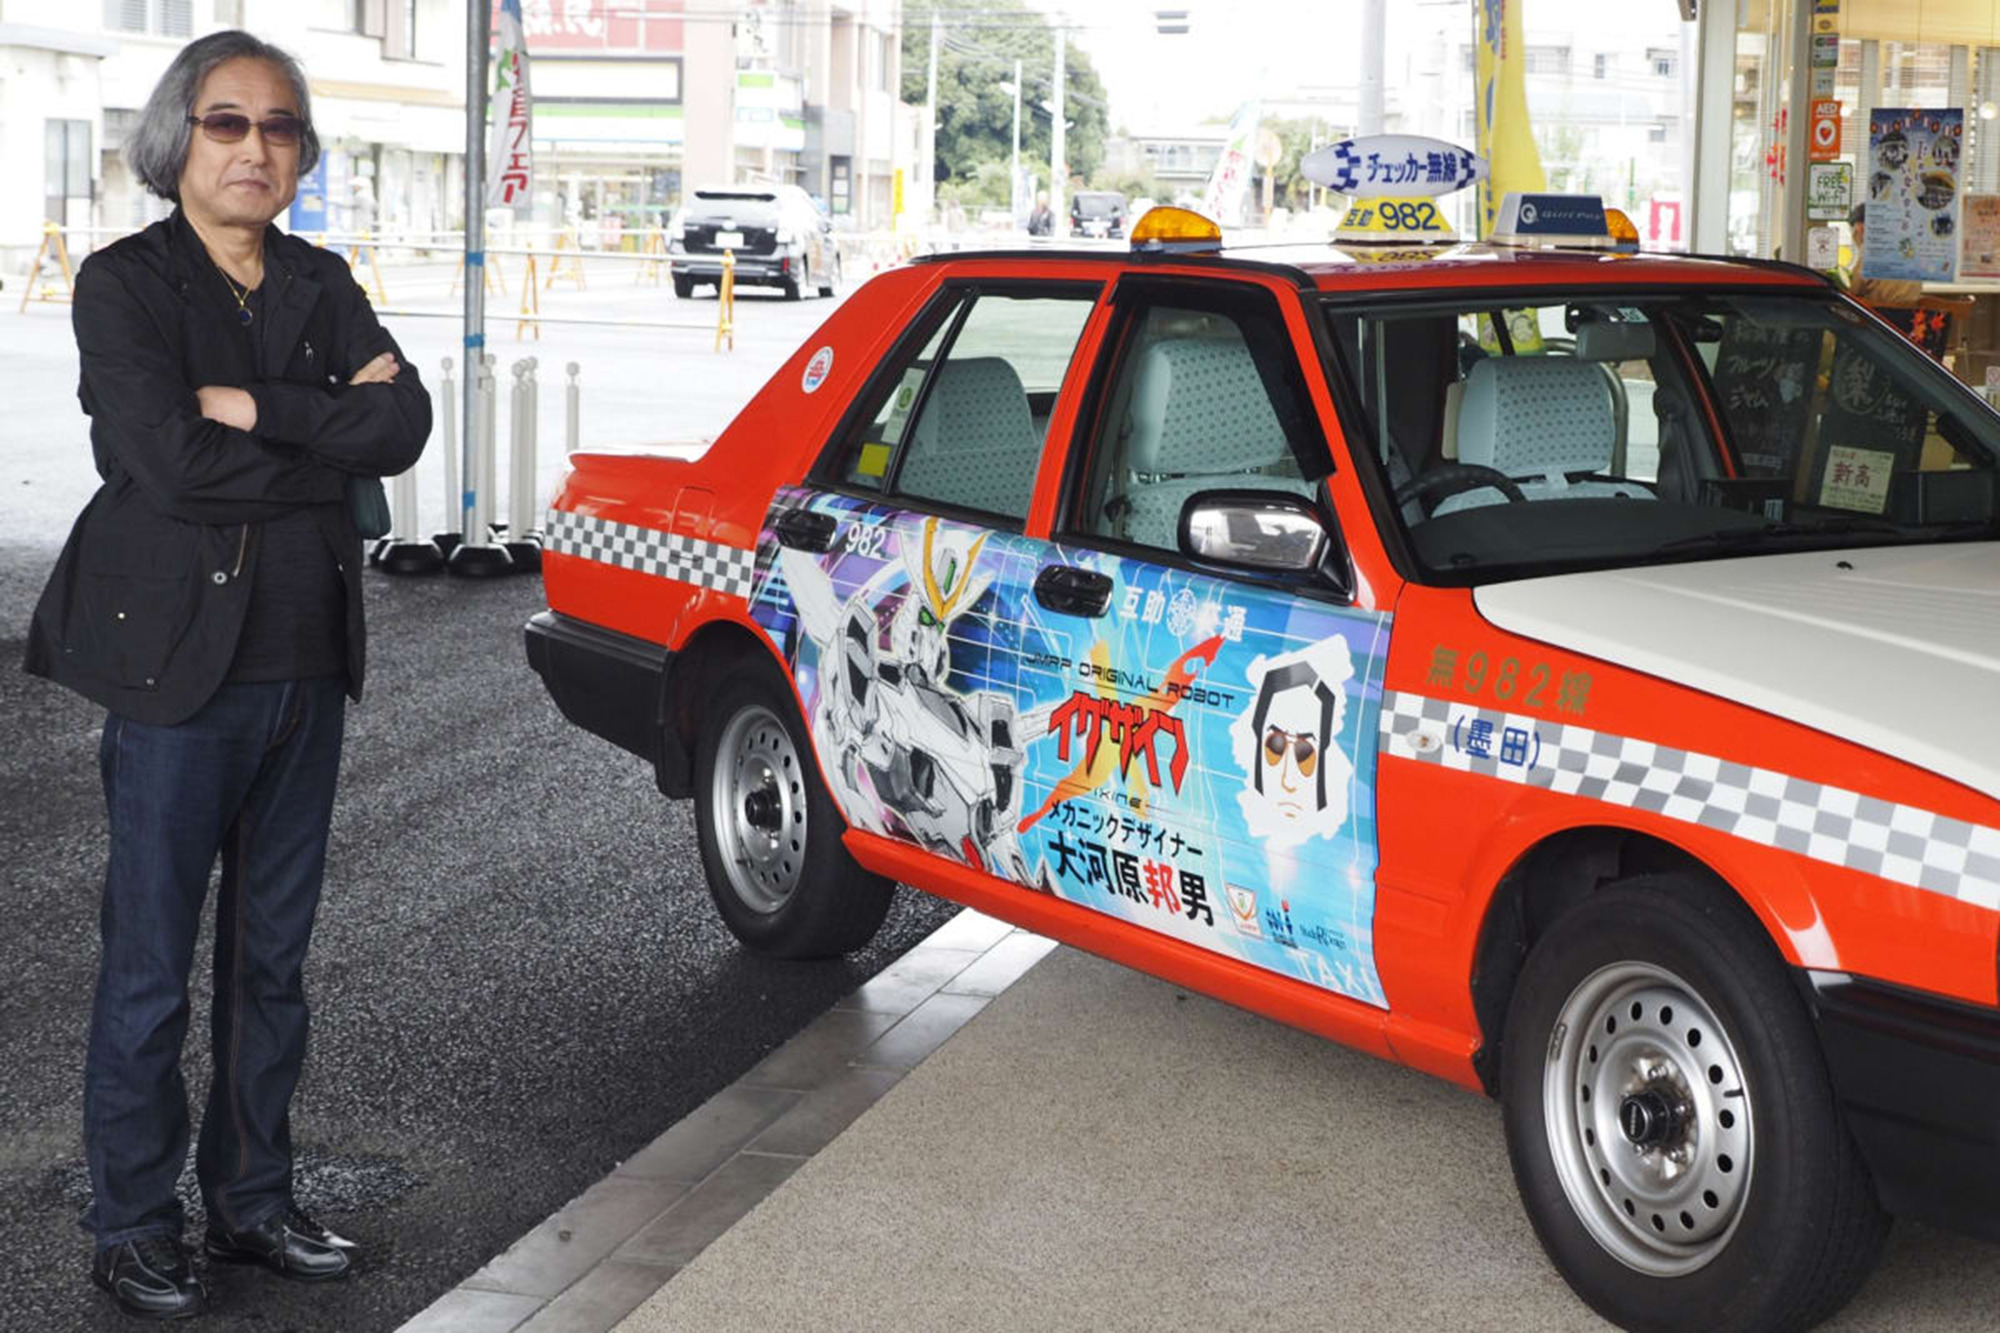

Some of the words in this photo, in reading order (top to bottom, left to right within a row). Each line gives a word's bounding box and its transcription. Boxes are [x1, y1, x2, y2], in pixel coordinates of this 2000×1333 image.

[1367, 152, 1458, 184] チェッカー無線
[1379, 202, 1440, 231] 982
[845, 522, 886, 558] 982
[1119, 585, 1166, 625] 互助
[1078, 661, 1159, 692] ORIGINAL
[1167, 681, 1235, 708] ROBOT
[1454, 715, 1540, 771] (墨田)
[1049, 799, 1204, 858] メカニックデザイナー
[1048, 831, 1214, 926] 大河原邦男
